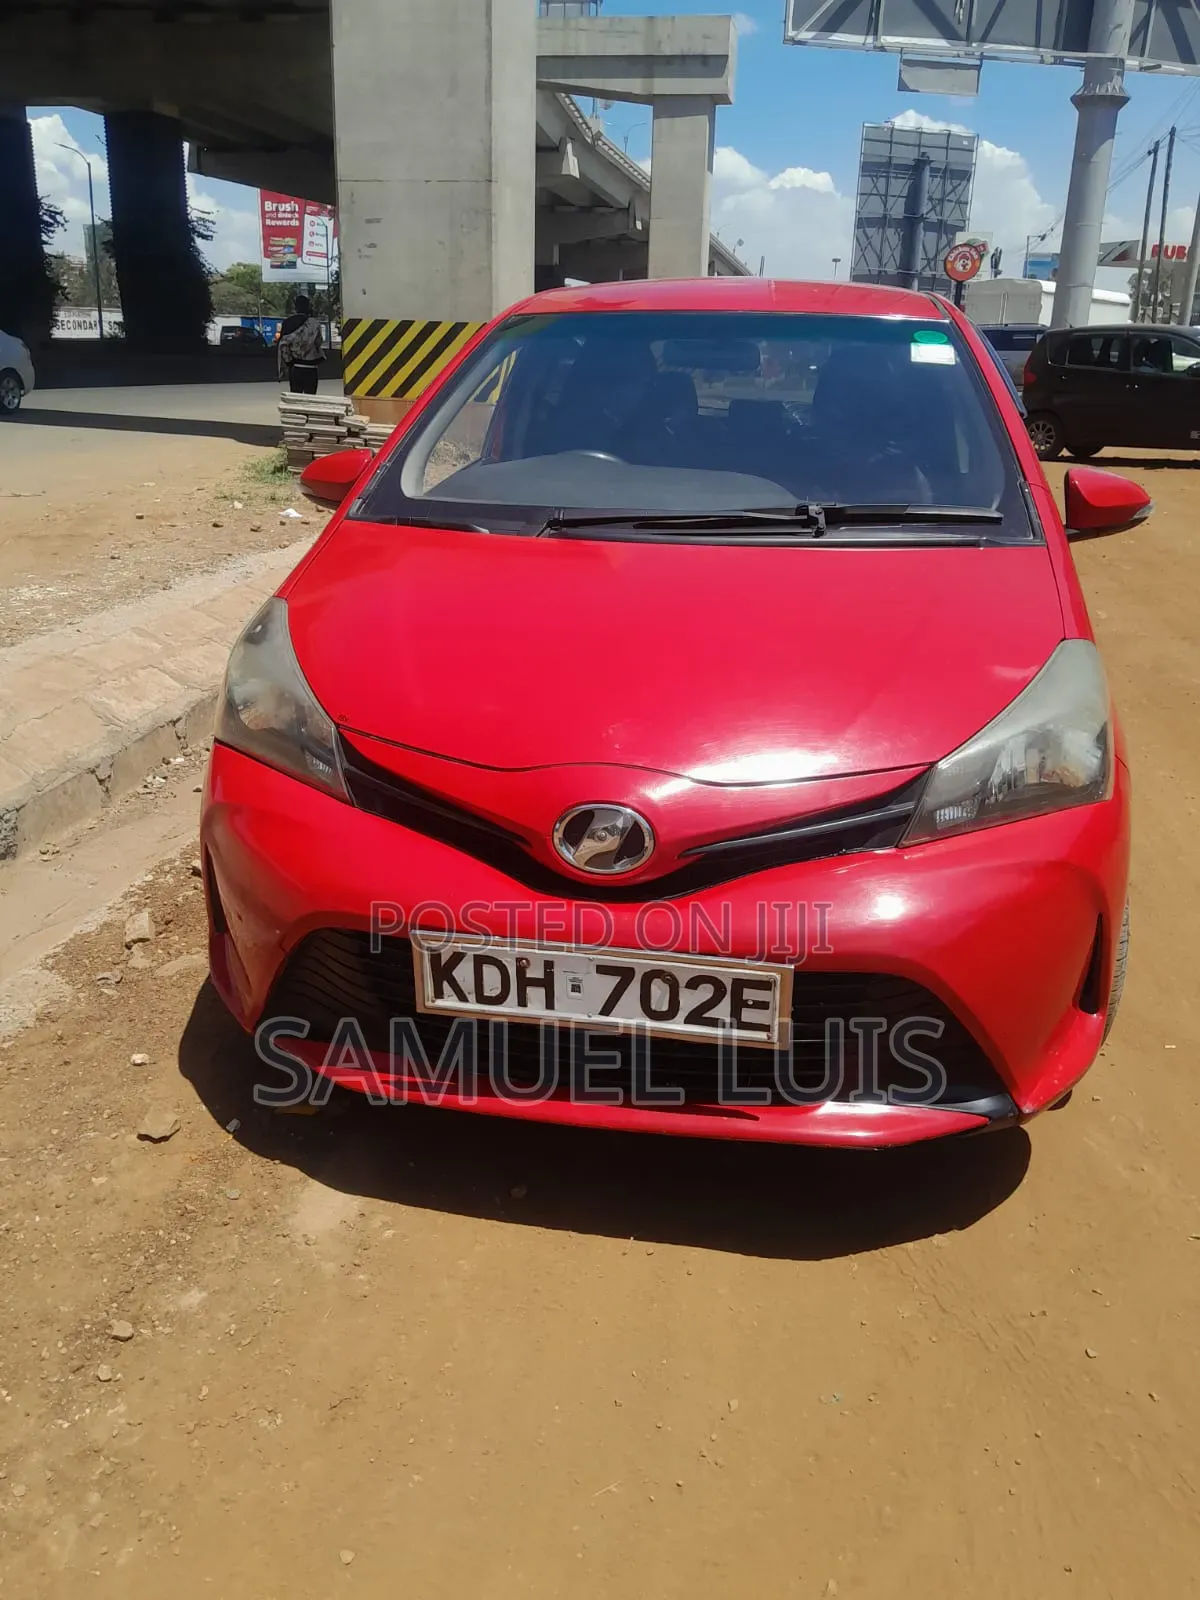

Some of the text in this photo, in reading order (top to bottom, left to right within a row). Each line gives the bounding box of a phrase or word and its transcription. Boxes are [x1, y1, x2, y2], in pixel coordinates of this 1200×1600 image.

[264, 200, 298, 212] Brush
[265, 218, 299, 226] Rewards
[56, 319, 103, 331] SECONDAR
[430, 950, 774, 1032] KDH 702E
